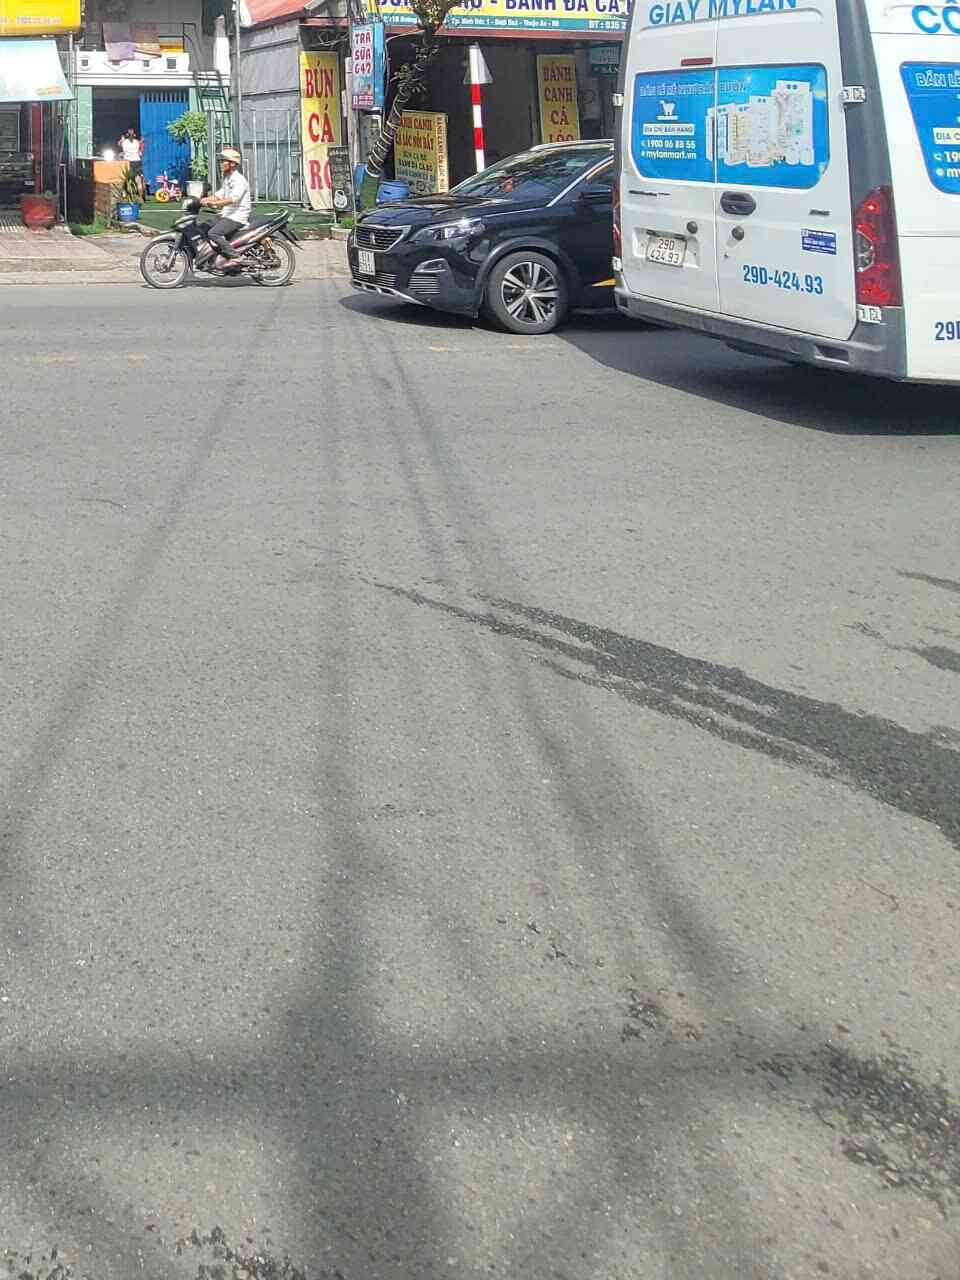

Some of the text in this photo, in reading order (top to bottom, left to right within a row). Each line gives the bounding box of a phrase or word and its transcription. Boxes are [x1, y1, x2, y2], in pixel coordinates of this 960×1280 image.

[305, 61, 334, 98] BÚN
[544, 87, 572, 102] CANH
[307, 104, 336, 143] CÁ
[550, 106, 569, 125] CÁ
[742, 264, 824, 295] 29D-424.93
